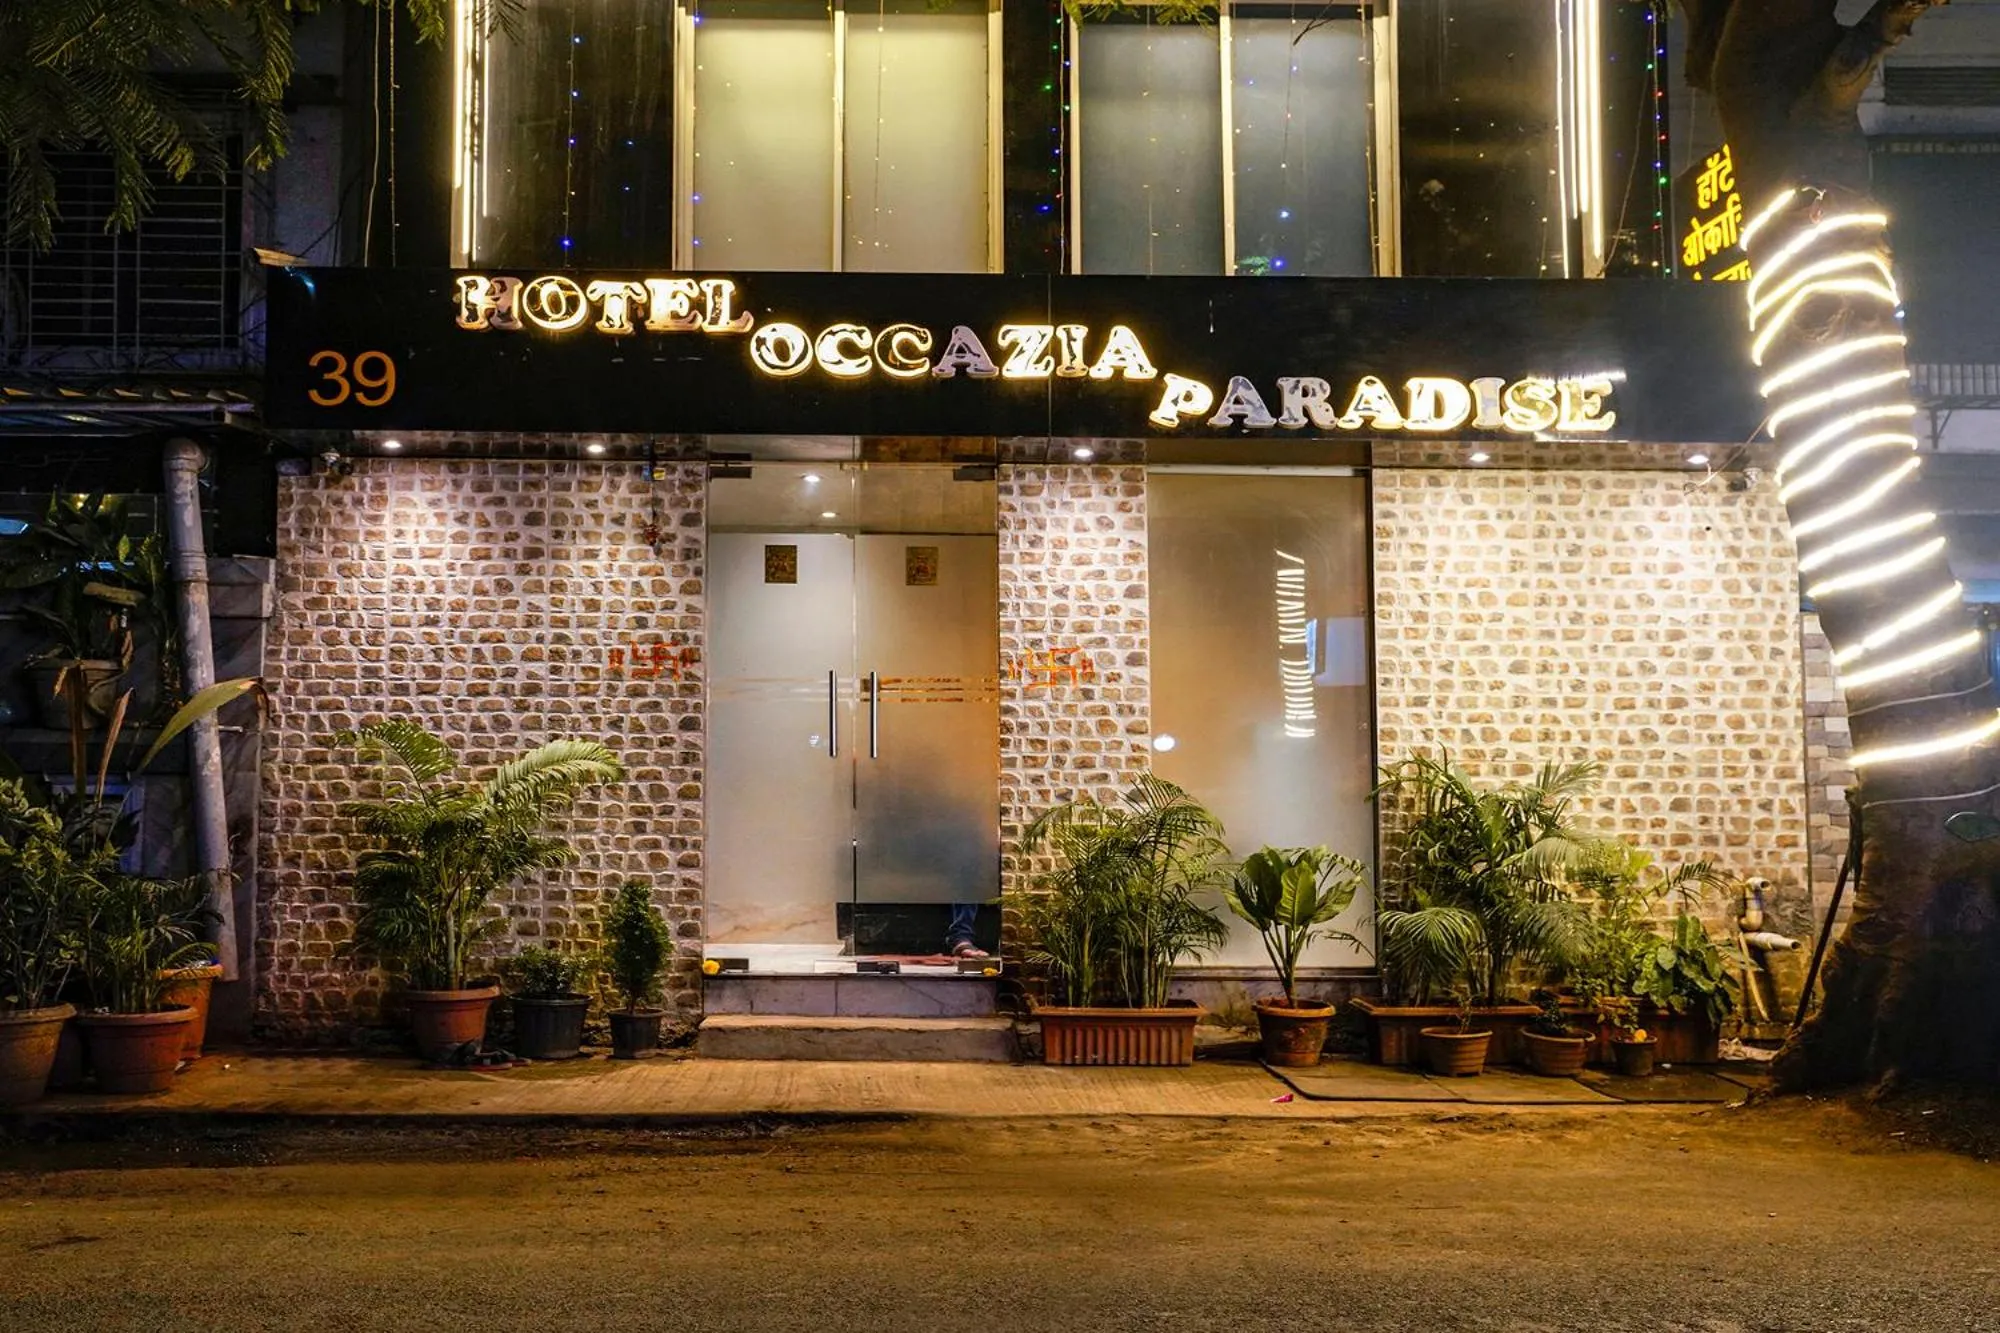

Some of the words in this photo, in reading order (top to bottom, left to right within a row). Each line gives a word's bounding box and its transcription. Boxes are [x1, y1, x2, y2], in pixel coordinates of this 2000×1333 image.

[1696, 143, 1735, 210] हॉटे
[307, 350, 398, 407] 39
[455, 275, 754, 335] HOTEL
[749, 322, 1158, 379] OCCAZIA
[1148, 373, 1618, 431] PARADISE
